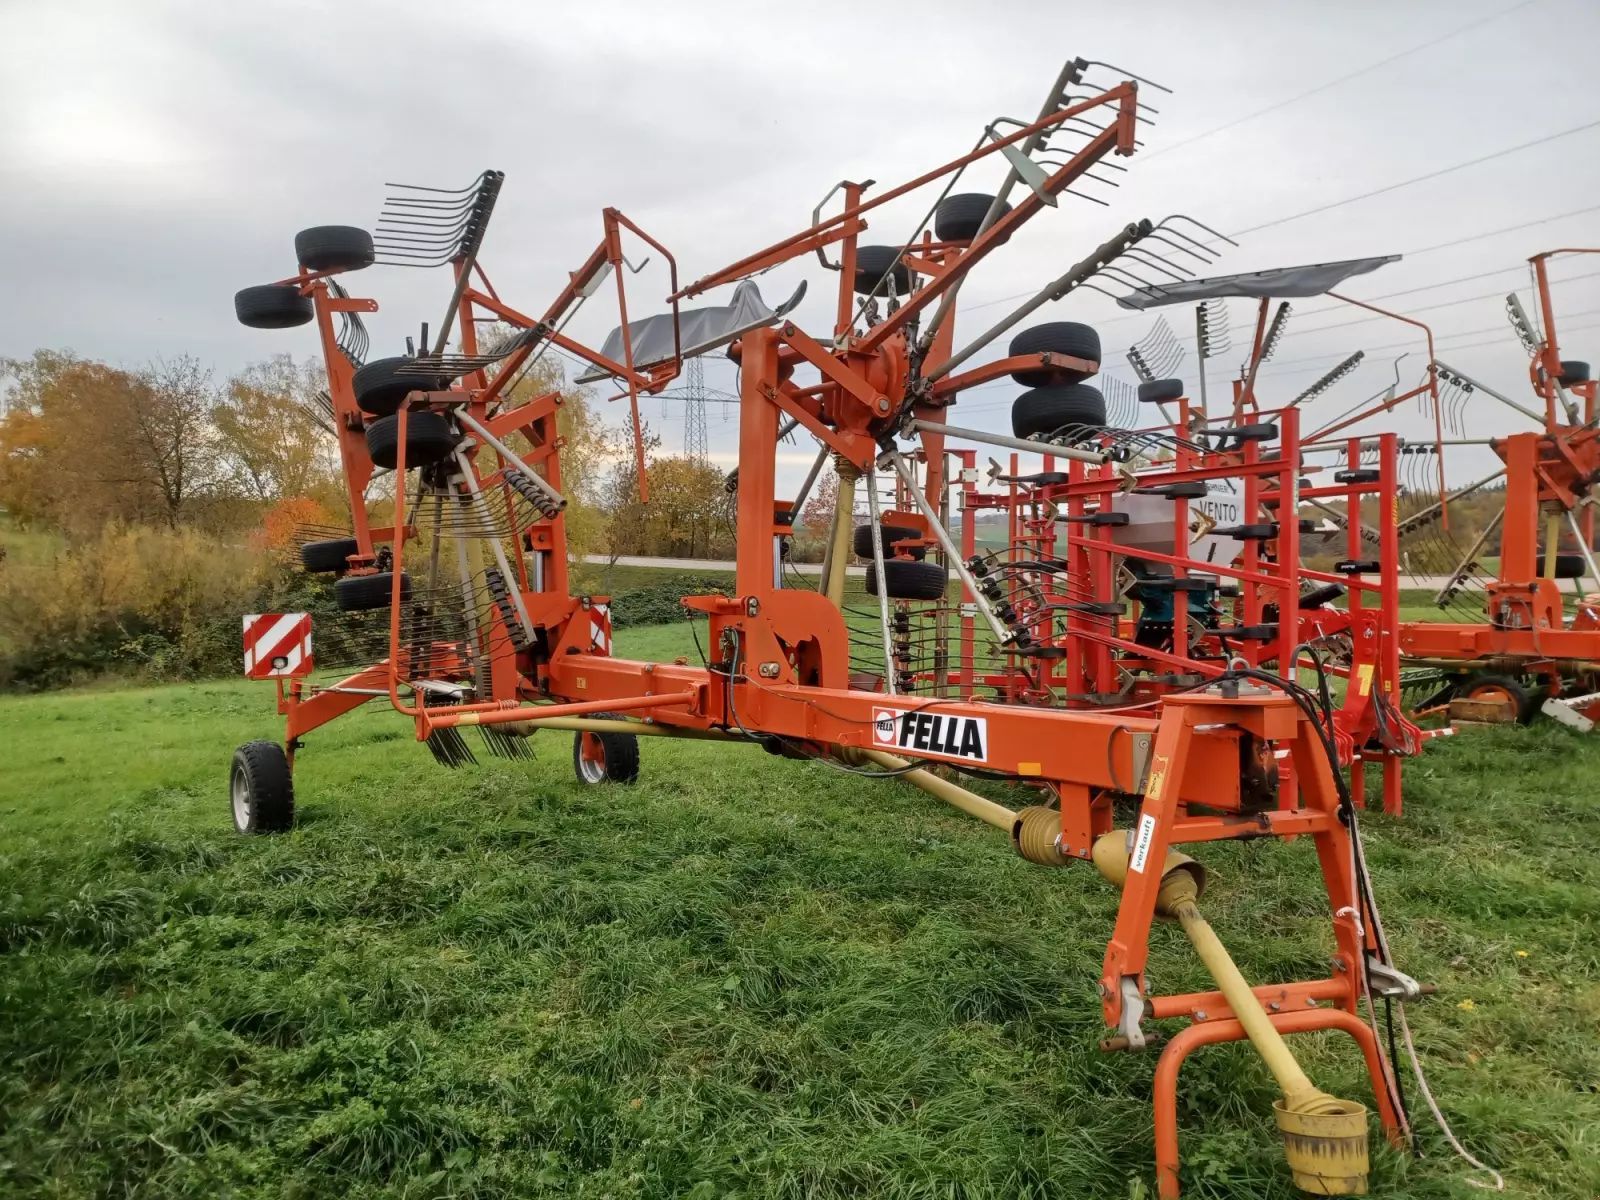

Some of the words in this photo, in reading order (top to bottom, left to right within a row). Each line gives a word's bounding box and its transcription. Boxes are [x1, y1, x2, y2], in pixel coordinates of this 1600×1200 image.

[1200, 500, 1237, 522] VENTO
[876, 720, 894, 732] FELLA
[899, 712, 984, 760] FELLA
[1136, 819, 1152, 867] verkauft
